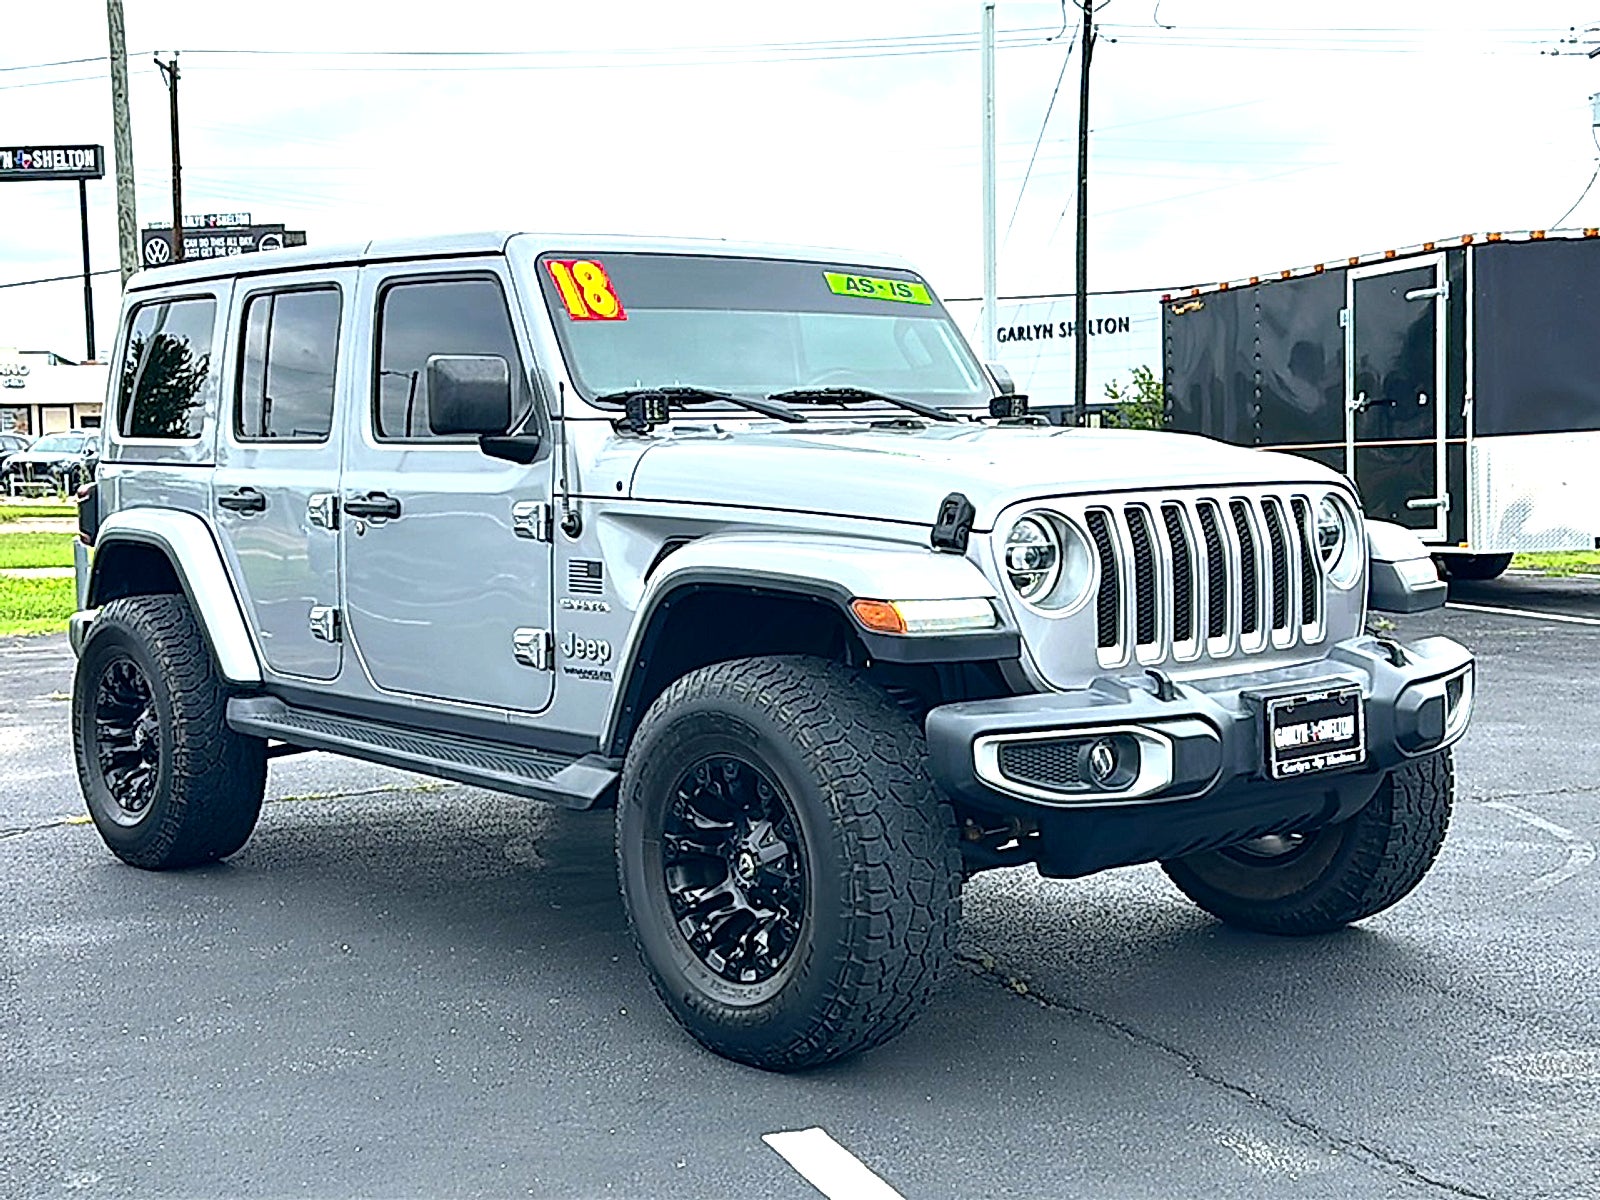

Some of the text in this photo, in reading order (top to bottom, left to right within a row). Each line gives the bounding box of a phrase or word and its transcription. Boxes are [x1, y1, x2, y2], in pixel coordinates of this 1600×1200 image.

[32, 149, 95, 168] SHELTON
[550, 261, 618, 317] 18
[996, 316, 1130, 343] GARLYN SHLTON
[560, 631, 612, 666] Jeep
